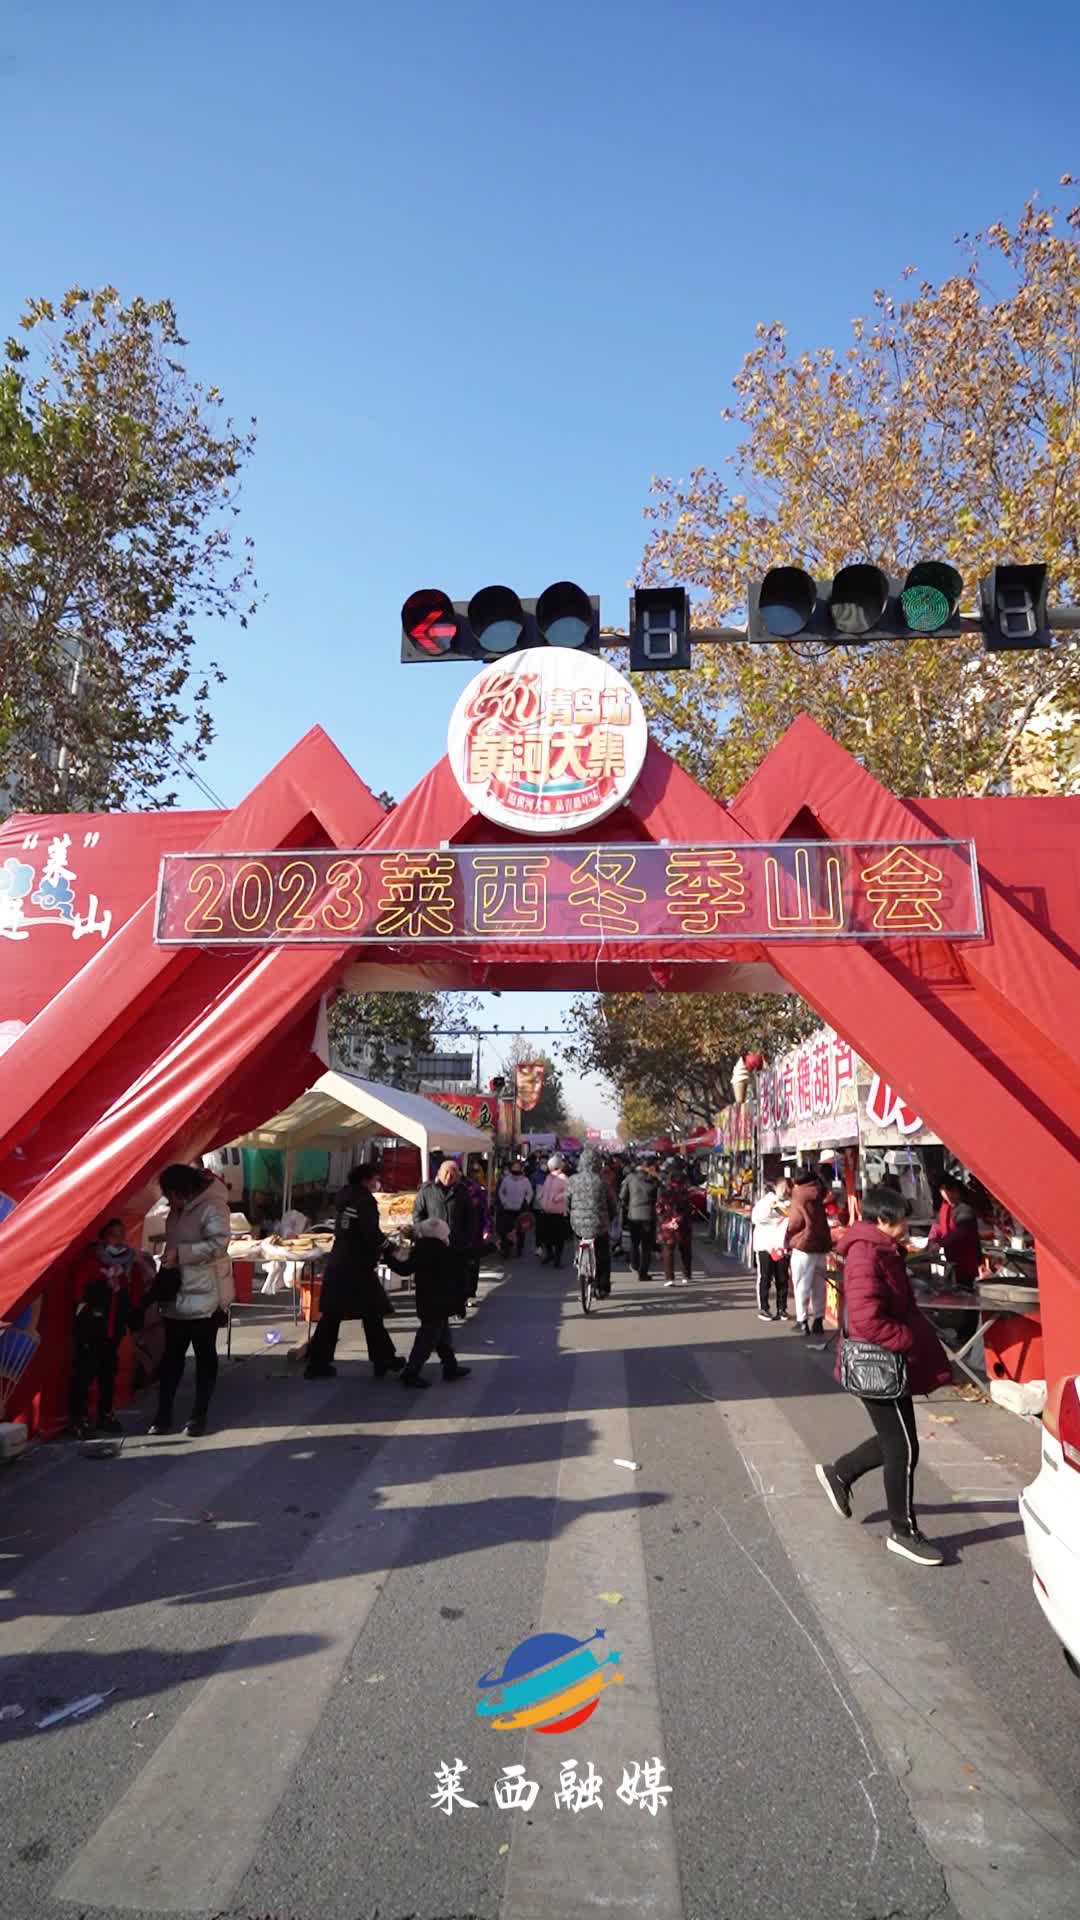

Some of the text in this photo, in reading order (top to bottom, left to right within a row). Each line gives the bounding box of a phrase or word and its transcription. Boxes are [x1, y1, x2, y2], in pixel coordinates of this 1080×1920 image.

[465, 729, 626, 784] 黄河大集
[184, 846, 943, 936] 2023莱西冬季山会
